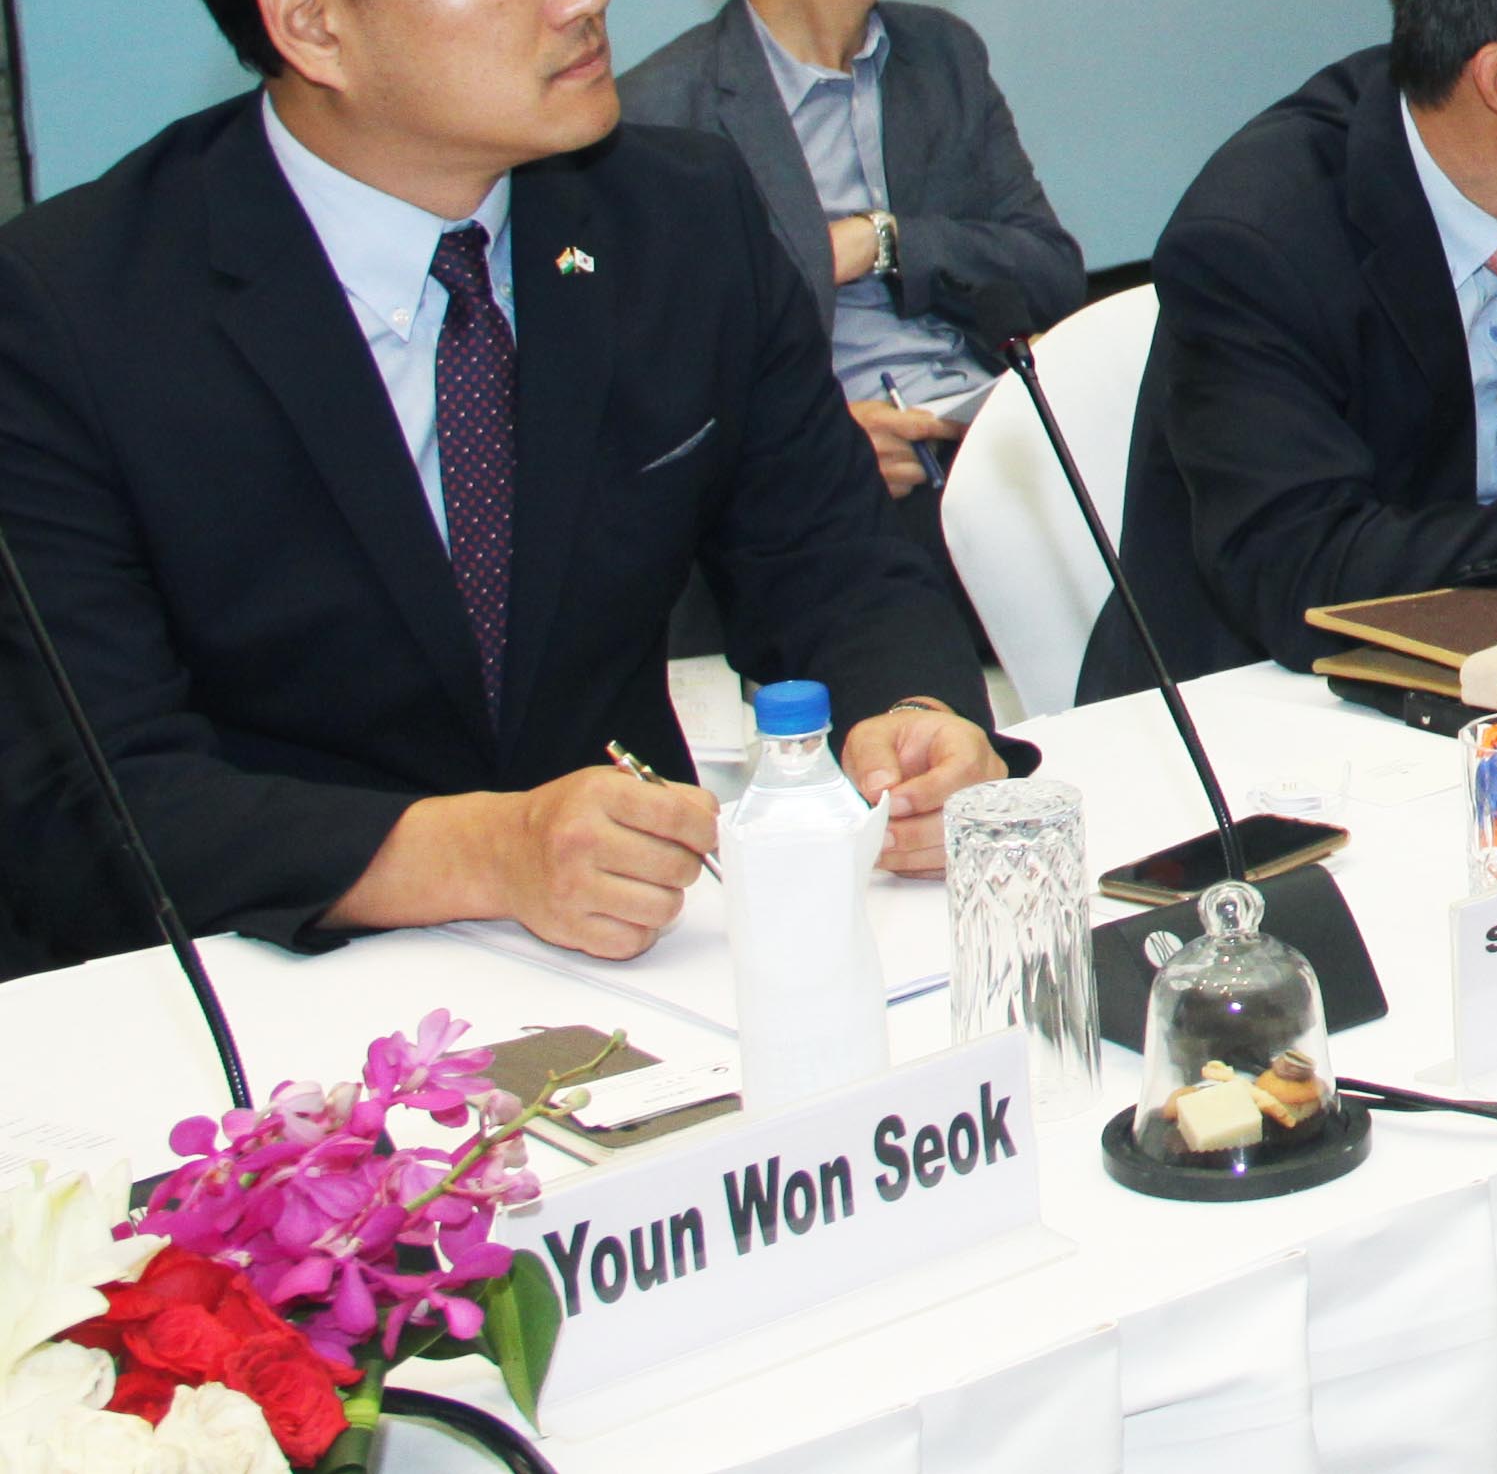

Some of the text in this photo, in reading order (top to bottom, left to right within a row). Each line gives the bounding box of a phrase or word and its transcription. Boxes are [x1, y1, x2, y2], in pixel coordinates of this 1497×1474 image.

[542, 1080, 1019, 1318] Youn Won Seok
